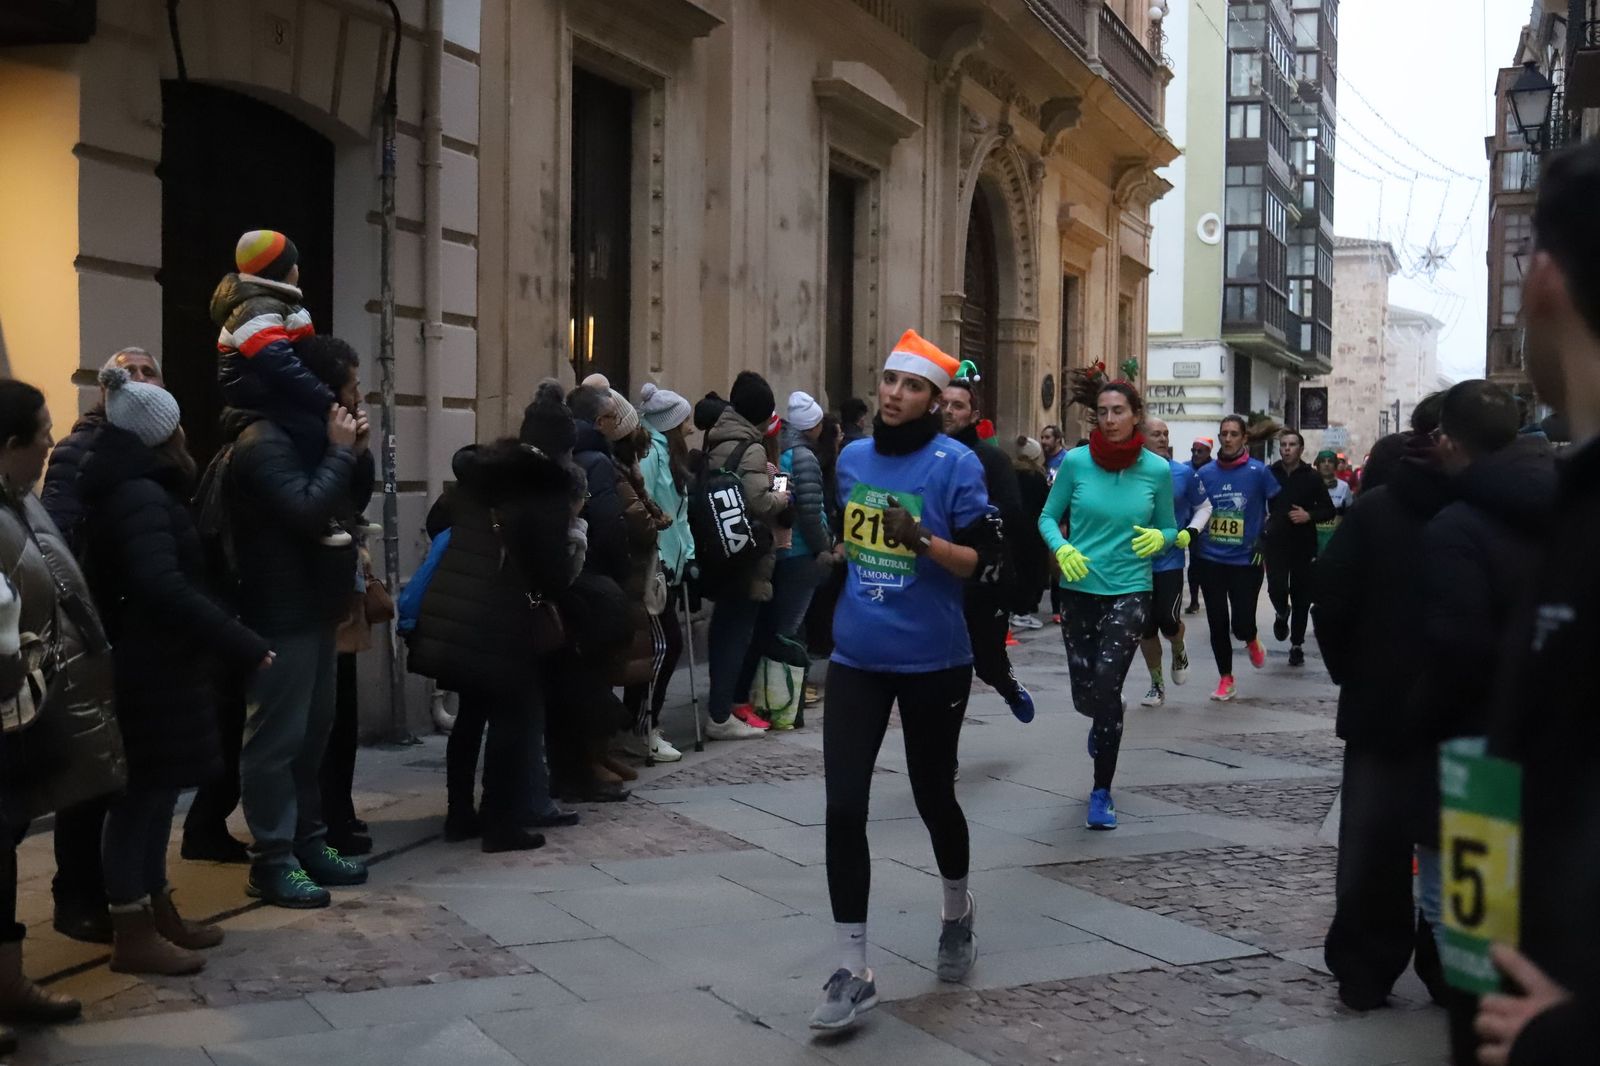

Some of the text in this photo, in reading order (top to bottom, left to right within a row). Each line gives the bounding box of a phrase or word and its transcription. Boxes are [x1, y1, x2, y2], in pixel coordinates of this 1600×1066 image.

[714, 488, 749, 553] FILA
[1210, 519, 1239, 535] 448
[879, 557, 910, 570] RURAL
[1451, 838, 1488, 929] 5
